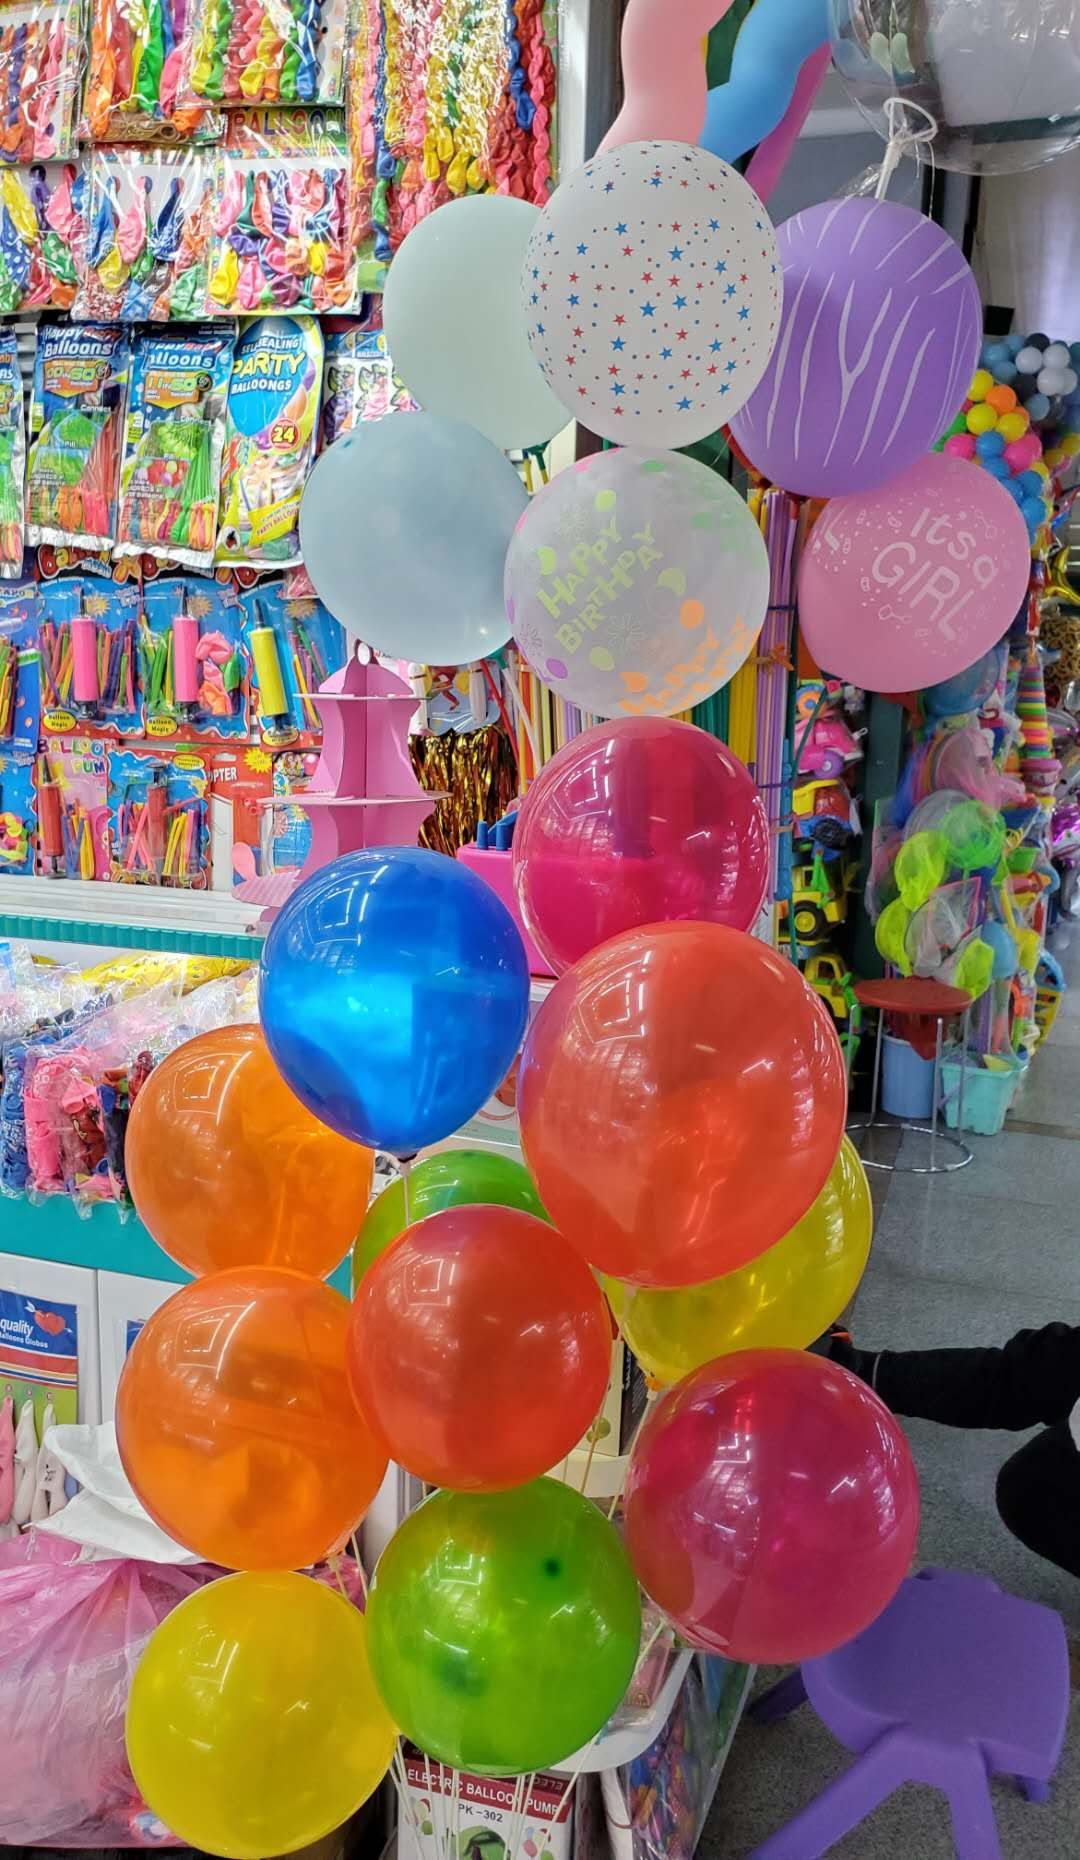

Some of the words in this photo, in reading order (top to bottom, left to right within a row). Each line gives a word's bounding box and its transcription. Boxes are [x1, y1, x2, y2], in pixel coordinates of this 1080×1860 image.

[45, 327, 84, 341] Happy
[44, 341, 112, 358] Balloons
[147, 352, 214, 368] alloons
[232, 351, 305, 378] PARTY
[231, 379, 292, 395] BALLOONGS
[272, 425, 296, 443] 24
[911, 508, 976, 560] It's
[972, 554, 998, 590] a
[536, 516, 622, 620] HAPPY
[554, 520, 664, 655] BIRTHDAY
[871, 541, 975, 640] GIRL
[0, 1319, 35, 1337] quality
[407, 1768, 464, 1793] ELECTRC
[466, 1781, 525, 1806] BALLOO
[527, 1797, 562, 1816] PUMP
